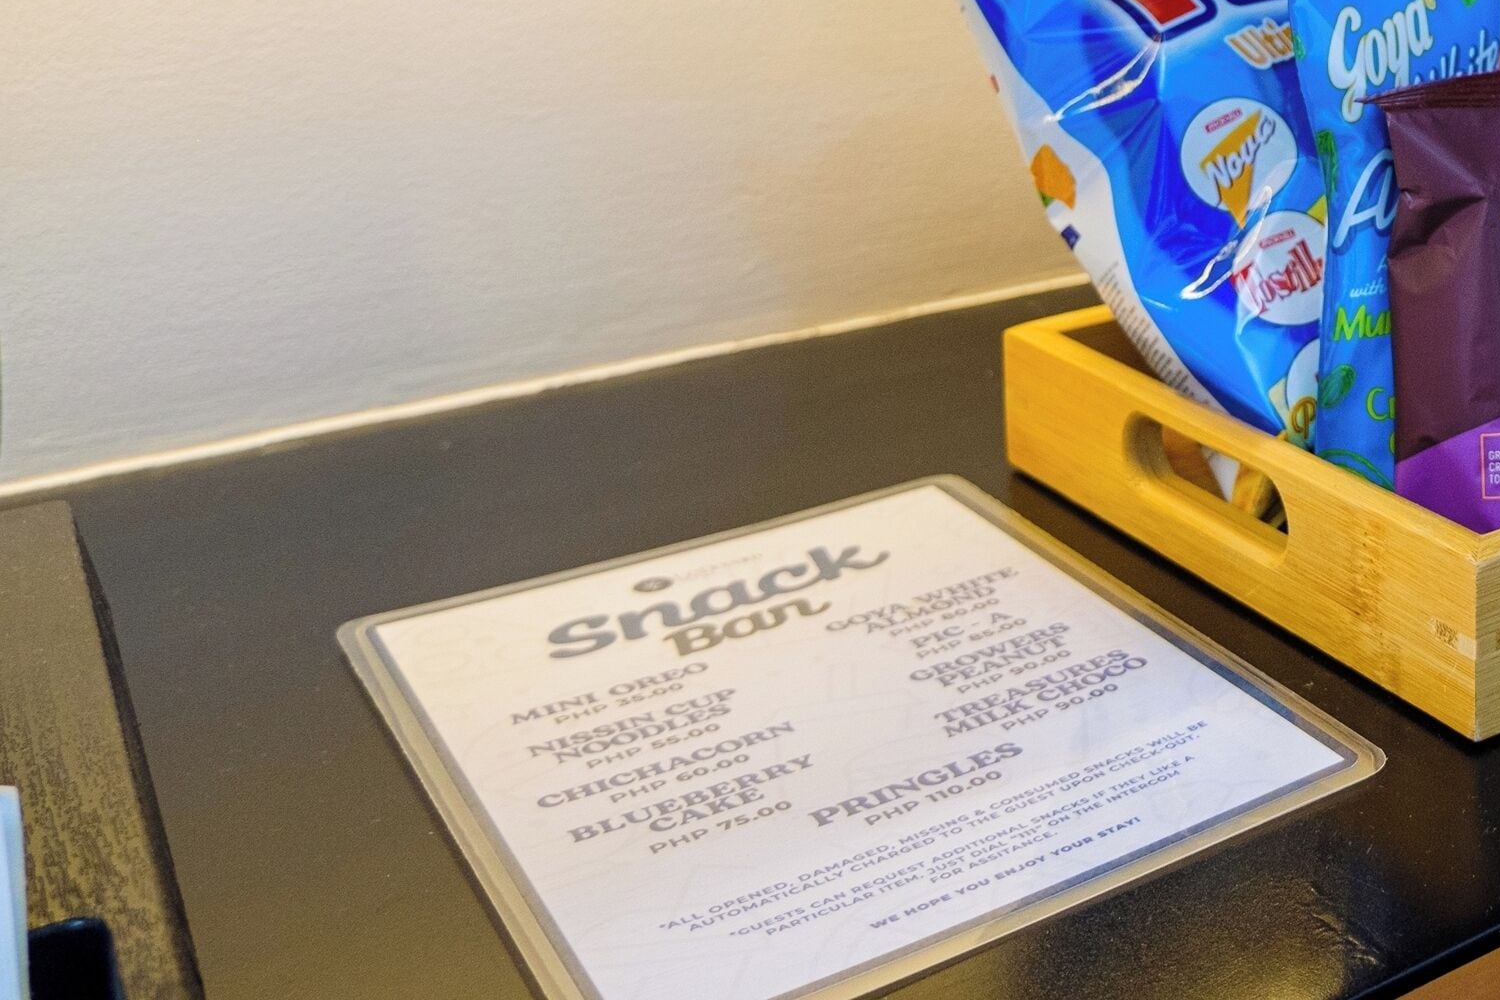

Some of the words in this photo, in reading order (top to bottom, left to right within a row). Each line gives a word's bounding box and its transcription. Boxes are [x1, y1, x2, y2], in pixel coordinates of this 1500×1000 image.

[548, 545, 891, 660] Snack
[825, 602, 904, 632] GOYA
[912, 567, 1019, 605] WHITE
[866, 586, 998, 634] ALMOND
[889, 618, 935, 637] PHP
[908, 624, 966, 649] PIC
[989, 610, 1013, 626] A
[908, 621, 1071, 683] GROWERS
[916, 638, 963, 660] PHP
[934, 634, 1068, 688] PEANUT
[956, 673, 1004, 694] PHP
[1009, 649, 1072, 676] 90.00
[511, 691, 600, 725] MINI
[608, 661, 709, 696] OREO
[555, 703, 608, 725] PHP
[933, 648, 1131, 724] TREASURES
[942, 699, 1033, 739] MILK
[1035, 655, 1149, 703] CHOCO
[1000, 708, 1051, 732] PHP
[1055, 682, 1120, 712] 90.00
[526, 711, 654, 757] NISSIN
[664, 687, 737, 716] CUP
[553, 703, 732, 764] NOODLES
[586, 745, 642, 769] PHP
[651, 722, 721, 750] 55.00
[537, 721, 796, 808] CHICHACORN
[609, 778, 667, 804] PHP
[675, 753, 750, 783] 60.00
[808, 741, 1024, 828] PRINGLES
[566, 753, 815, 844] BLUEBERRY
[648, 787, 766, 834] CAKE
[649, 827, 709, 854] PHP
[716, 800, 793, 832] 75.00
[707, 880, 793, 915] OPENED,
[797, 843, 896, 882] DAMAGED,
[898, 813, 971, 845] MISSING
[974, 808, 986, 818] &
[989, 770, 1081, 811] CONSUMED
[1082, 744, 1146, 775] SNACKS
[1145, 729, 1188, 749] WILL
[1188, 719, 1209, 733] BE
[863, 799, 920, 827] PHP
[924, 769, 1003, 804] 110.00
[688, 868, 844, 933] AUTOMATICALLY
[849, 836, 937, 873] CHARGED
[938, 825, 964, 842] TO
[967, 810, 1004, 832] THE
[1005, 789, 1056, 815] GUEST
[1058, 769, 1107, 793] UPON
[1108, 732, 1202, 773] CHECK-OUT.
[764, 889, 876, 937] PARTICULAR
[926, 854, 969, 876] JUST
[970, 839, 1009, 860] DIAL
[1046, 813, 1072, 828] ON
[1071, 799, 1106, 820] THE
[1105, 769, 1182, 804] INTERCOM
[809, 891, 848, 910] CAN
[849, 862, 927, 895] REQUEST
[931, 816, 1028, 864] ADDITIONAL
[1030, 796, 1095, 825] SNACKS
[1092, 787, 1109, 800] IF
[1103, 772, 1147, 797] THEY
[1147, 759, 1185, 779] LIKE
[1183, 753, 1197, 763] A
[929, 865, 967, 885] FOR
[967, 830, 1060, 871] ASSITANCE.
[869, 913, 902, 930] WE
[903, 892, 953, 918] HOPE
[954, 877, 992, 896] YOU
[993, 854, 1047, 881] ENJOY
[1049, 835, 1095, 857] YOUR
[1095, 815, 1142, 839] STAY!
